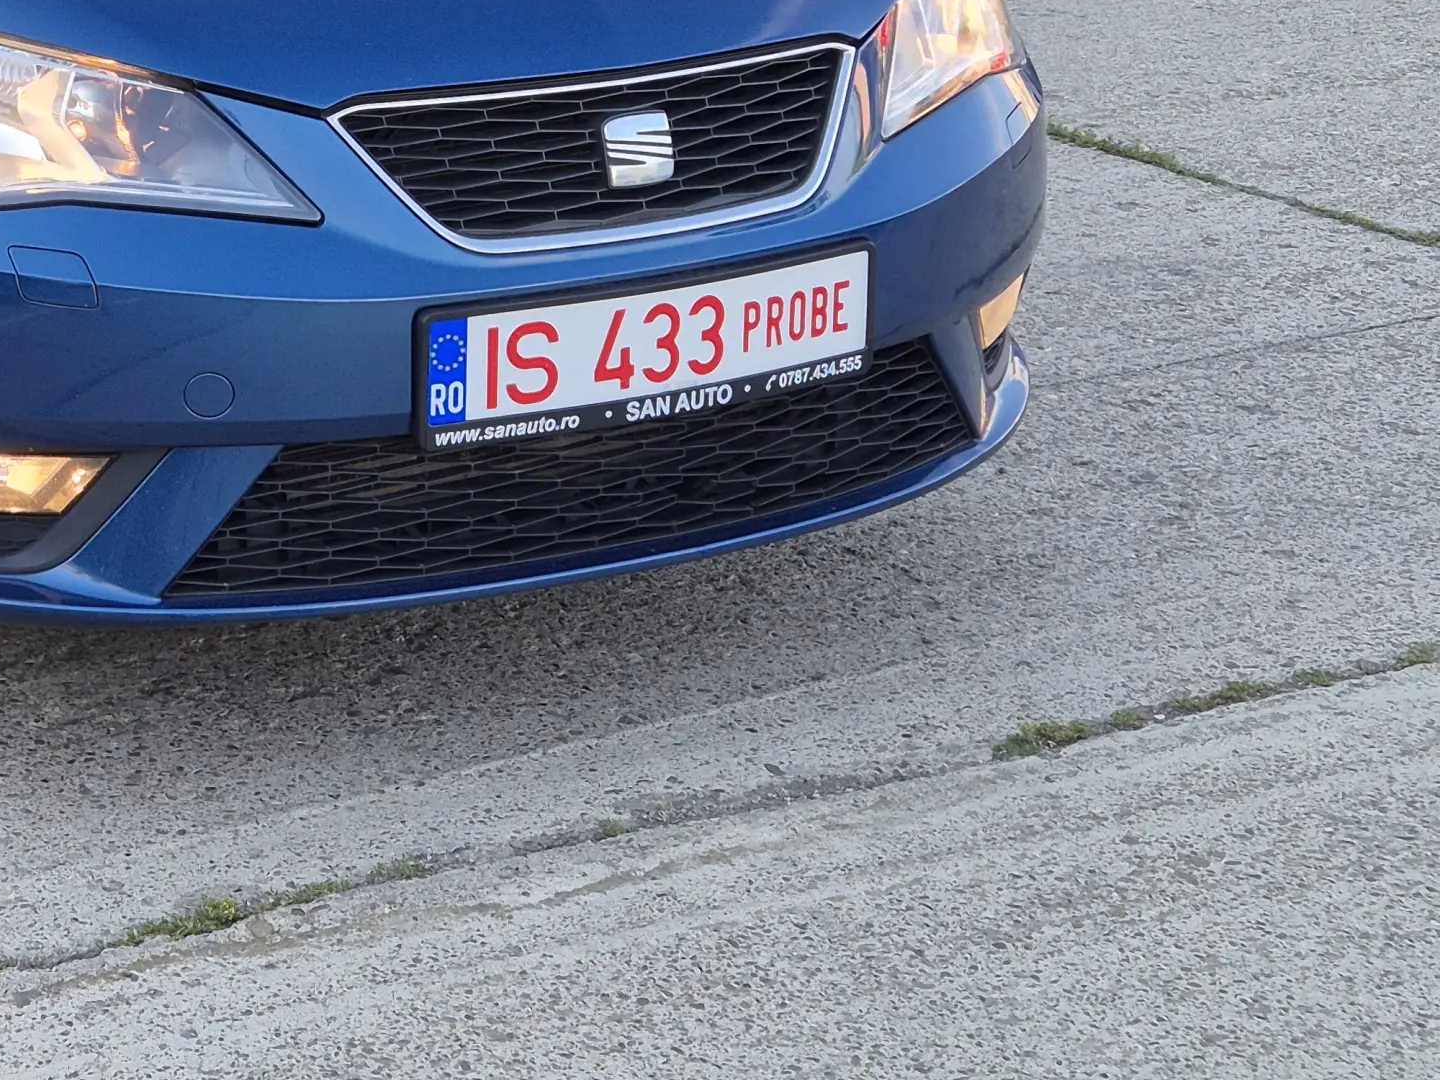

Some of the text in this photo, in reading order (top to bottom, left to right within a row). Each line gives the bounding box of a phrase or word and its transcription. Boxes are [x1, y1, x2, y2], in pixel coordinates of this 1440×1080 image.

[486, 279, 851, 410] IS 433 PROBE
[429, 380, 464, 417] RO
[434, 414, 580, 447] www.sanauto.ro
[625, 395, 671, 422] SAN
[674, 383, 733, 414] AUTO
